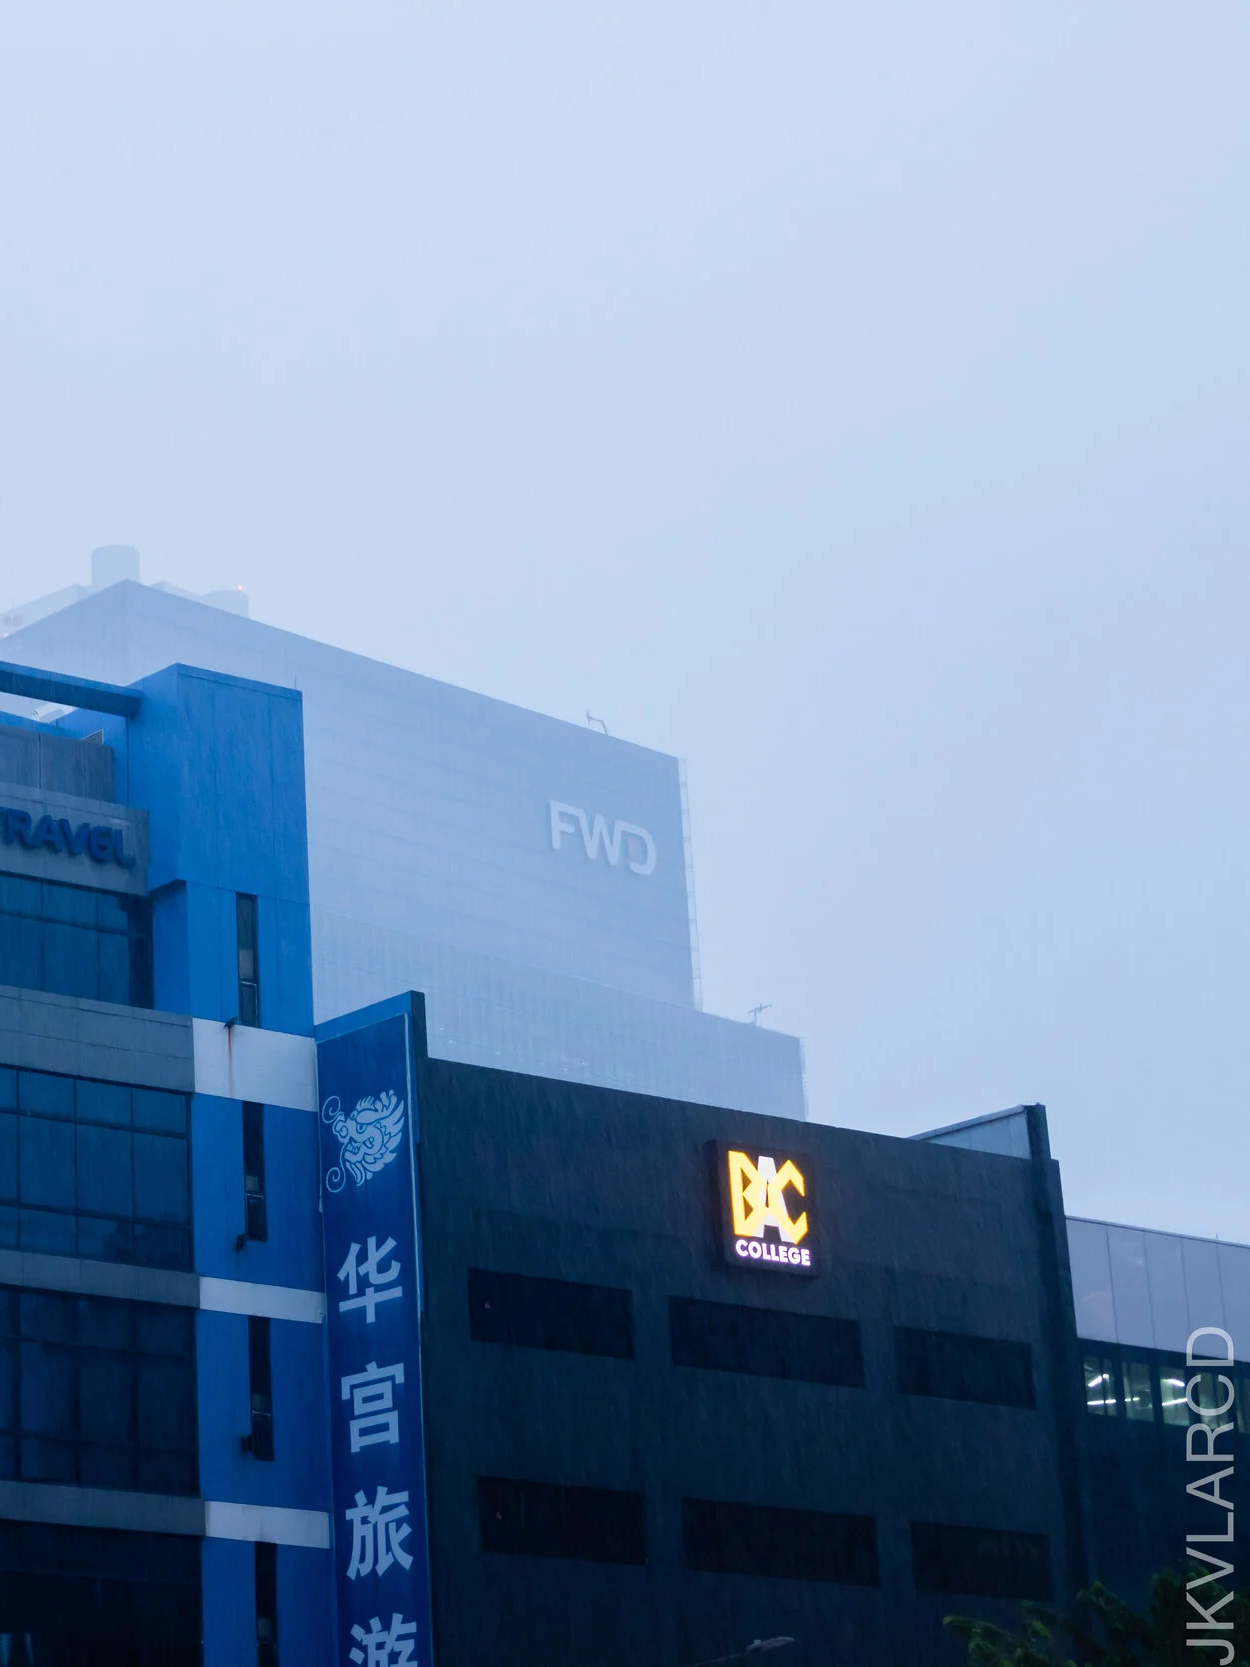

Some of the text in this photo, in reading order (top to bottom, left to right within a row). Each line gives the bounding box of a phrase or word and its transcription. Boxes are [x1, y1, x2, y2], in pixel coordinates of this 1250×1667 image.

[550, 800, 657, 875] FWD
[728, 1150, 809, 1244] BAC
[735, 1239, 811, 1266] COLLEGE
